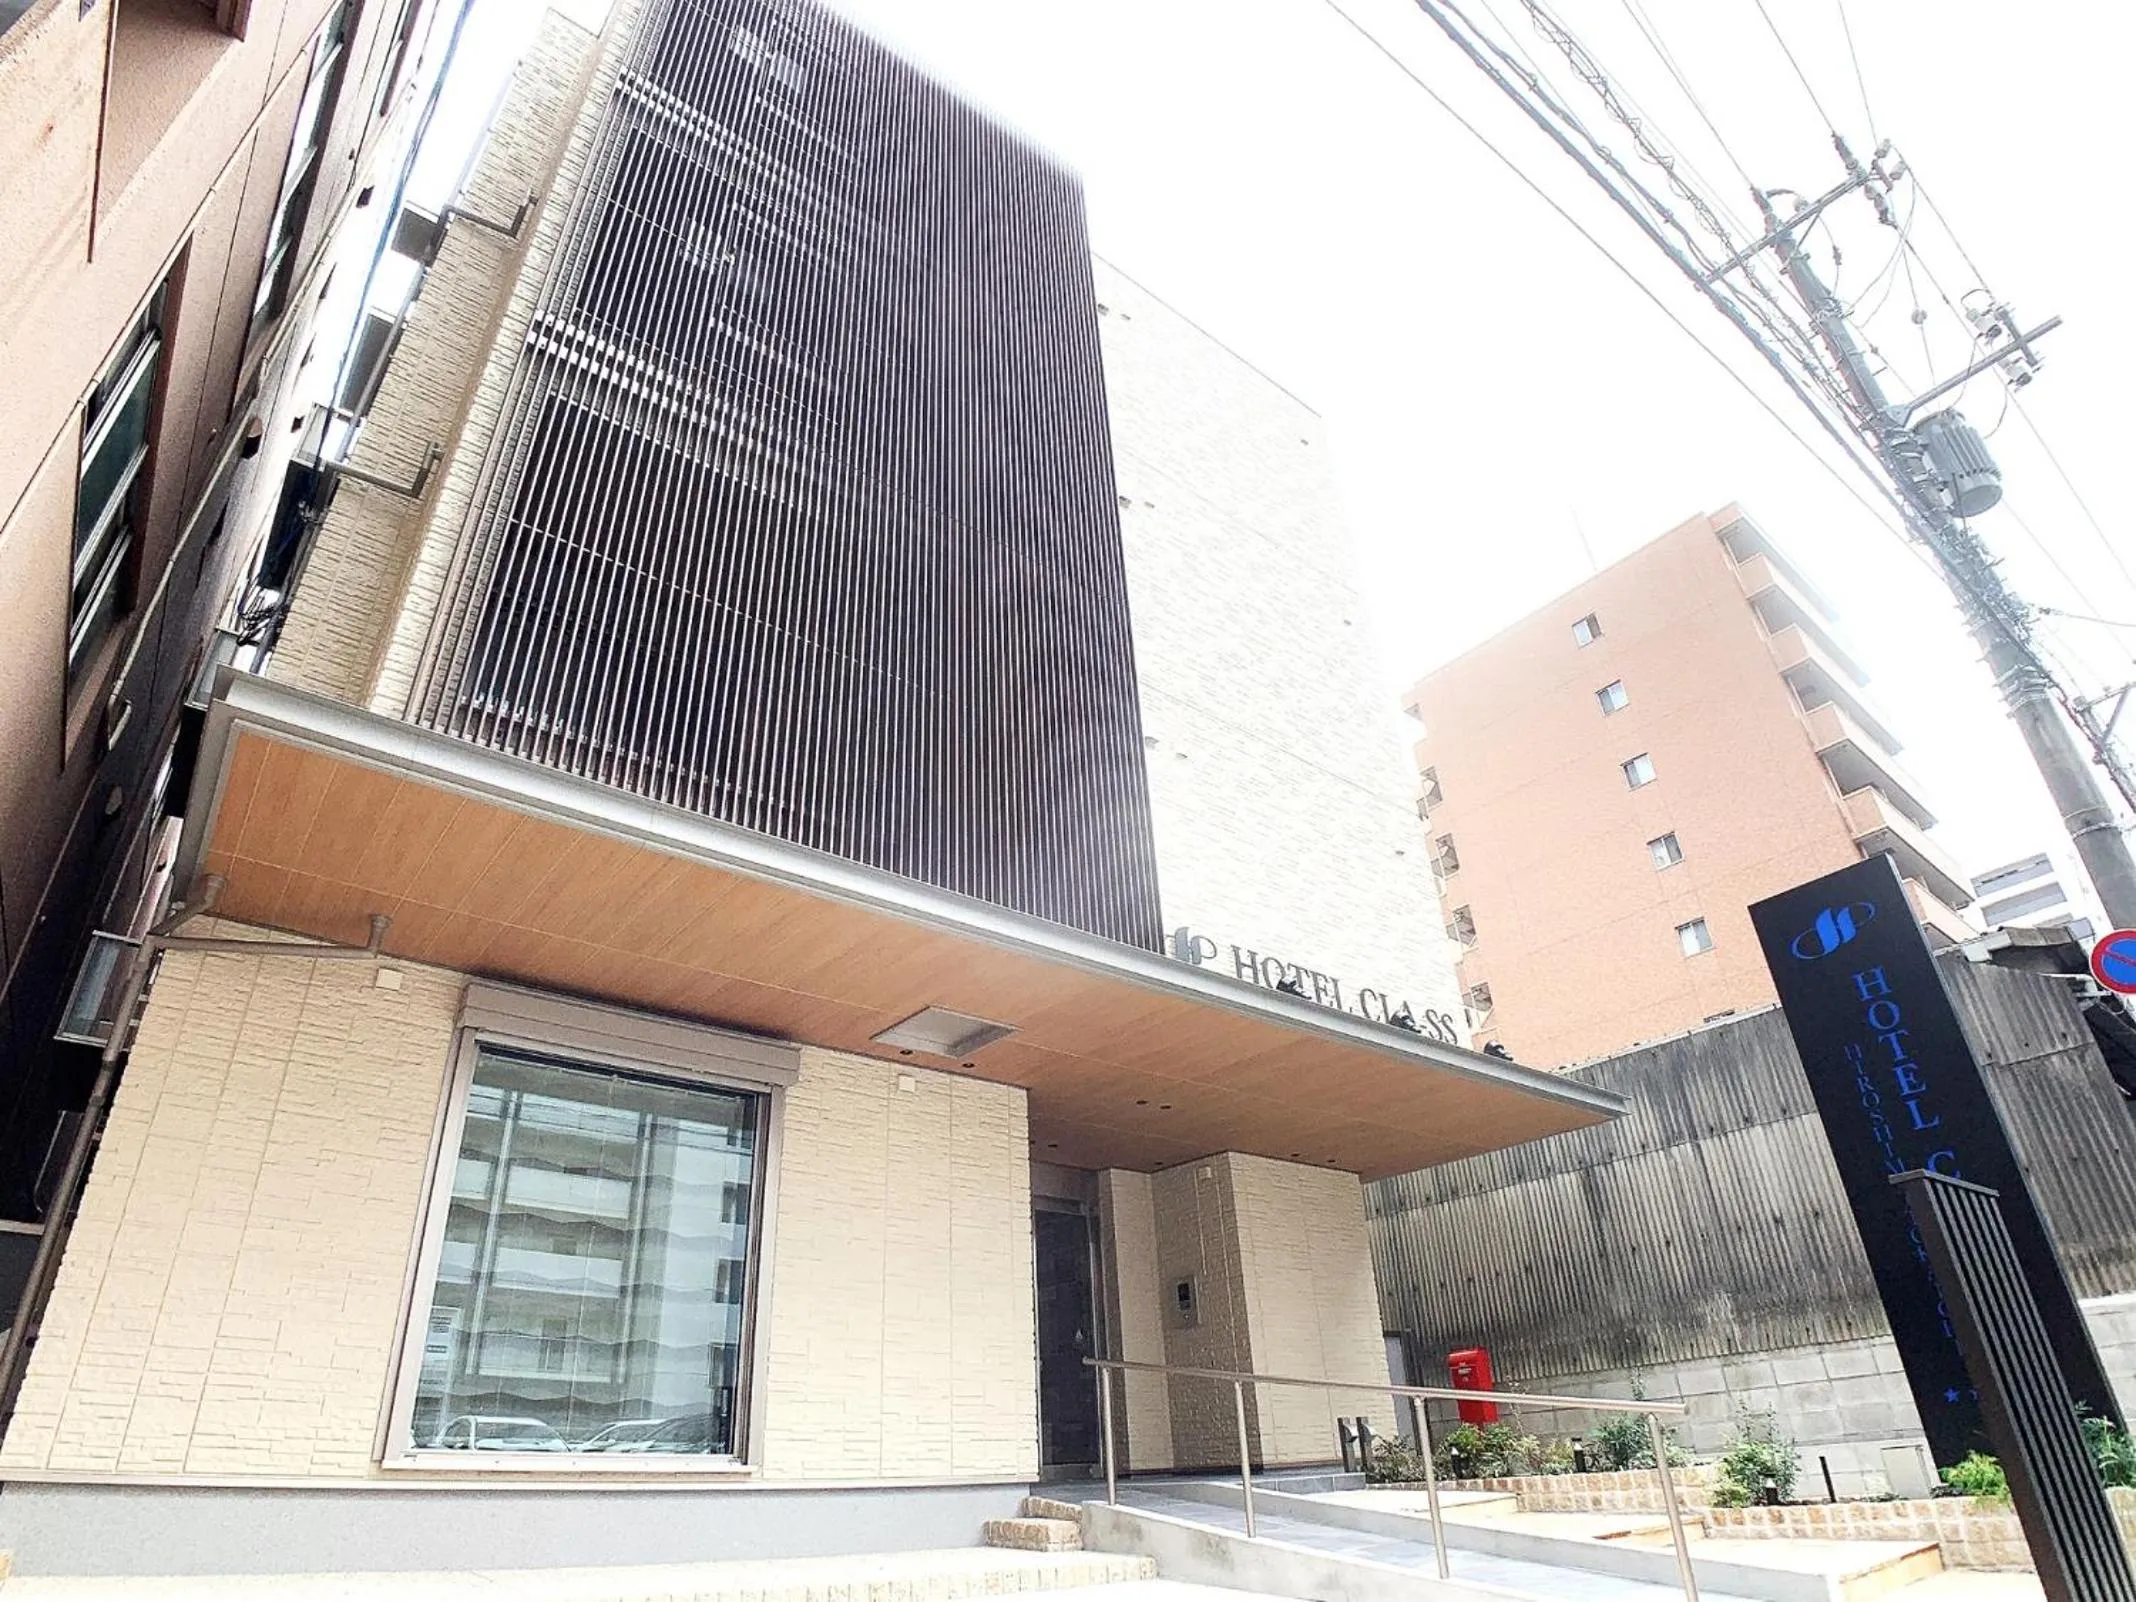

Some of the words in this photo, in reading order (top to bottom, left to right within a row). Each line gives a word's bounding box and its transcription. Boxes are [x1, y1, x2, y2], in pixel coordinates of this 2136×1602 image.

[1231, 944, 1353, 1013] HOTEL
[1359, 988, 1457, 1044] CLASS
[1853, 966, 1940, 1130] HOTEL
[1844, 1043, 1905, 1173] HIROSHIM
